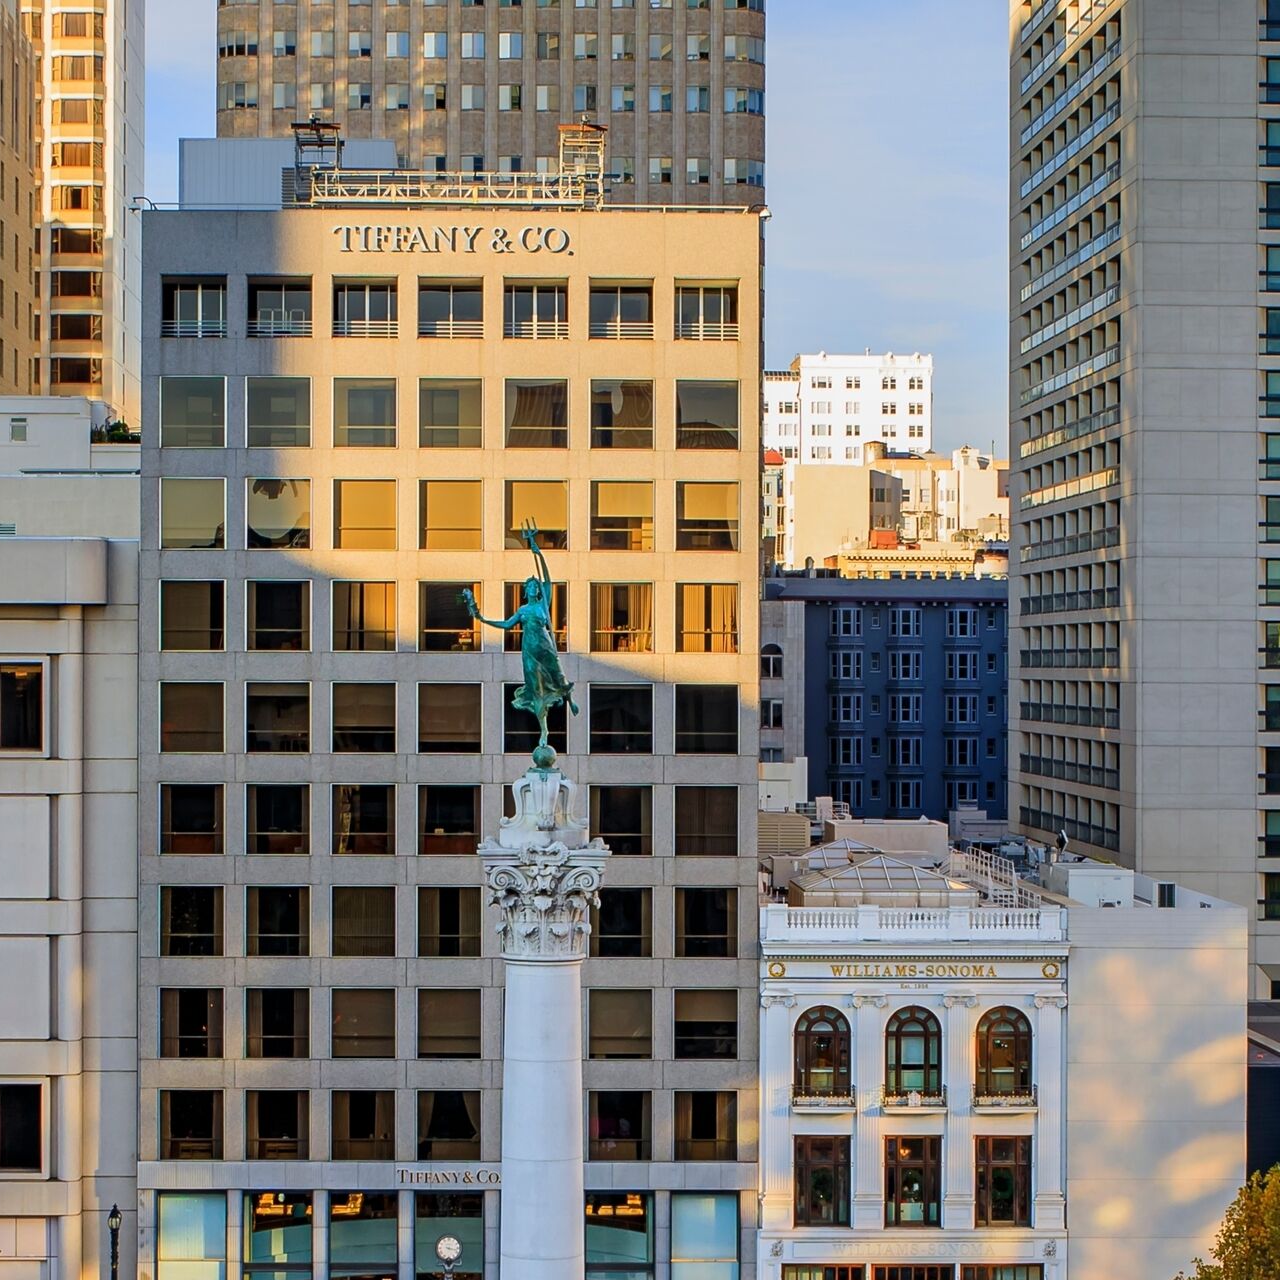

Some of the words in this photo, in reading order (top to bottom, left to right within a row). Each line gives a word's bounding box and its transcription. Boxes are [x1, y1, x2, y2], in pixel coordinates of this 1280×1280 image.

[333, 225, 484, 254] TIFFANY
[490, 226, 515, 254] &
[519, 226, 575, 256] CO.
[830, 964, 997, 977] WILLIAMS-SONOMA
[462, 1170, 474, 1184] &
